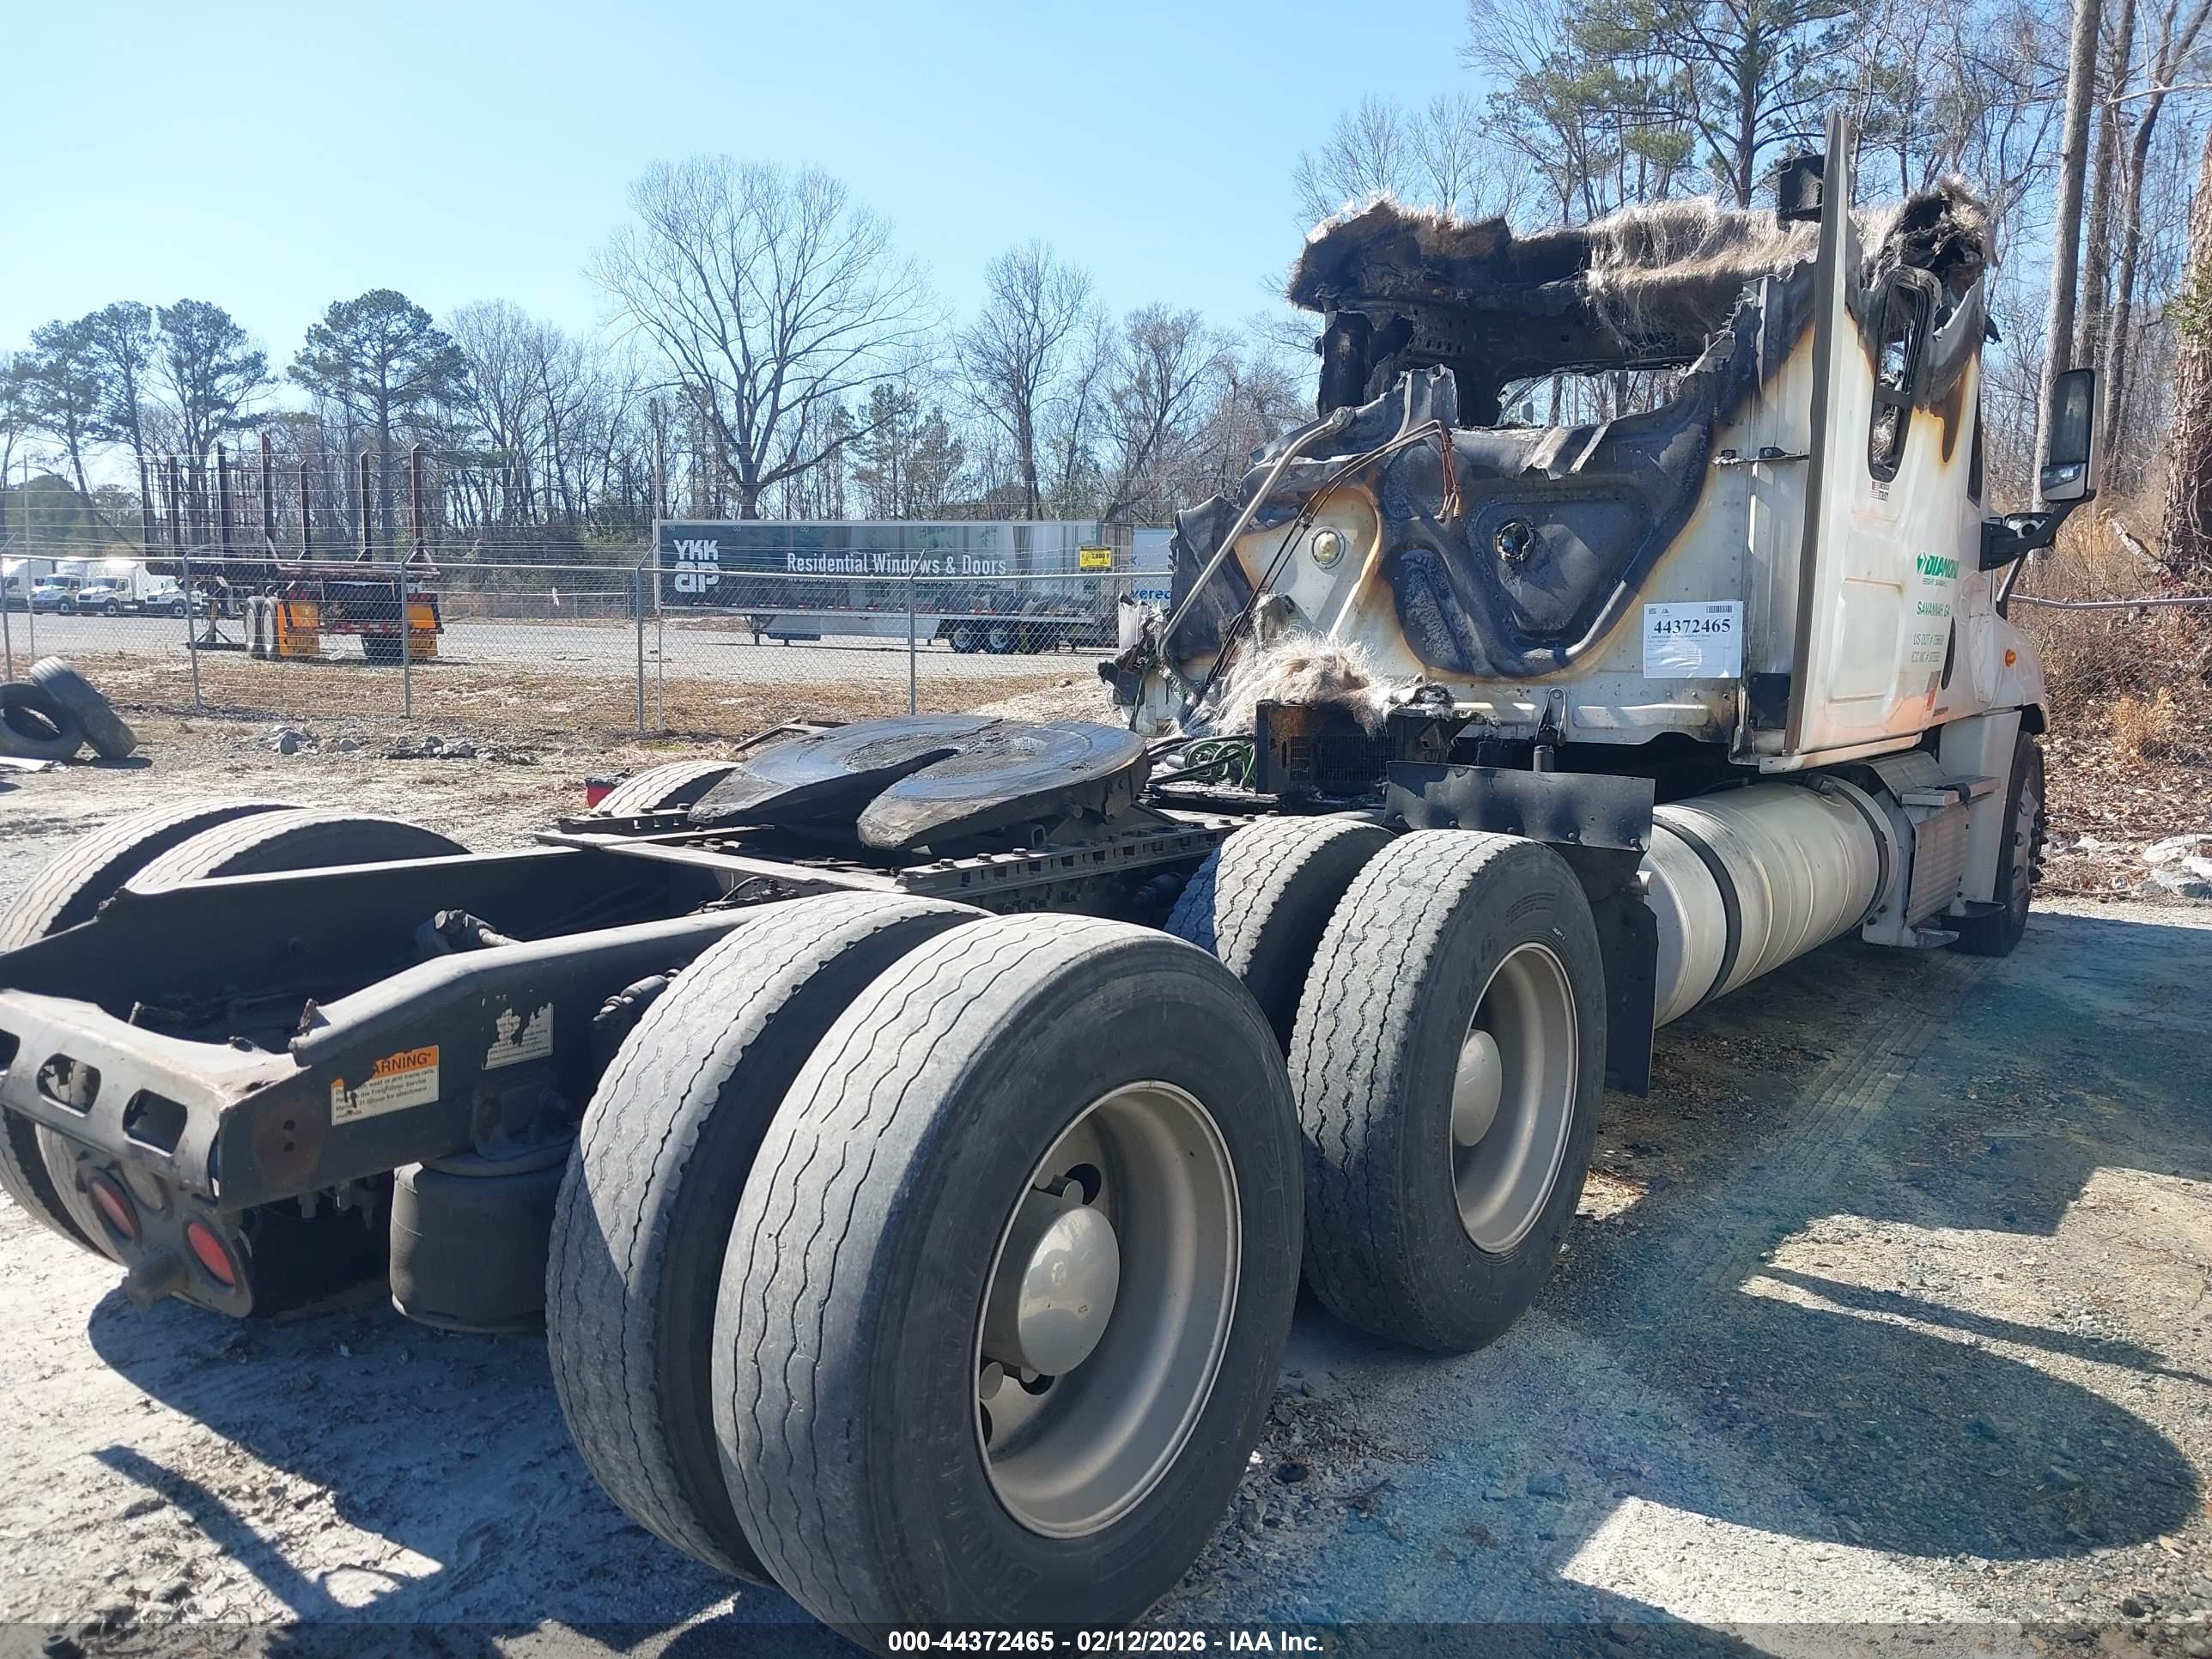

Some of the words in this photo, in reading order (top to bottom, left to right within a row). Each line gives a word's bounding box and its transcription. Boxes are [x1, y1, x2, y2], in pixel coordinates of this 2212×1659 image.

[673, 539, 719, 561] YKK
[787, 552, 869, 574] Residential
[872, 552, 940, 574] Windows
[945, 556, 956, 574] &
[962, 554, 1006, 575] Doors
[1653, 618, 1731, 634] 44372465
